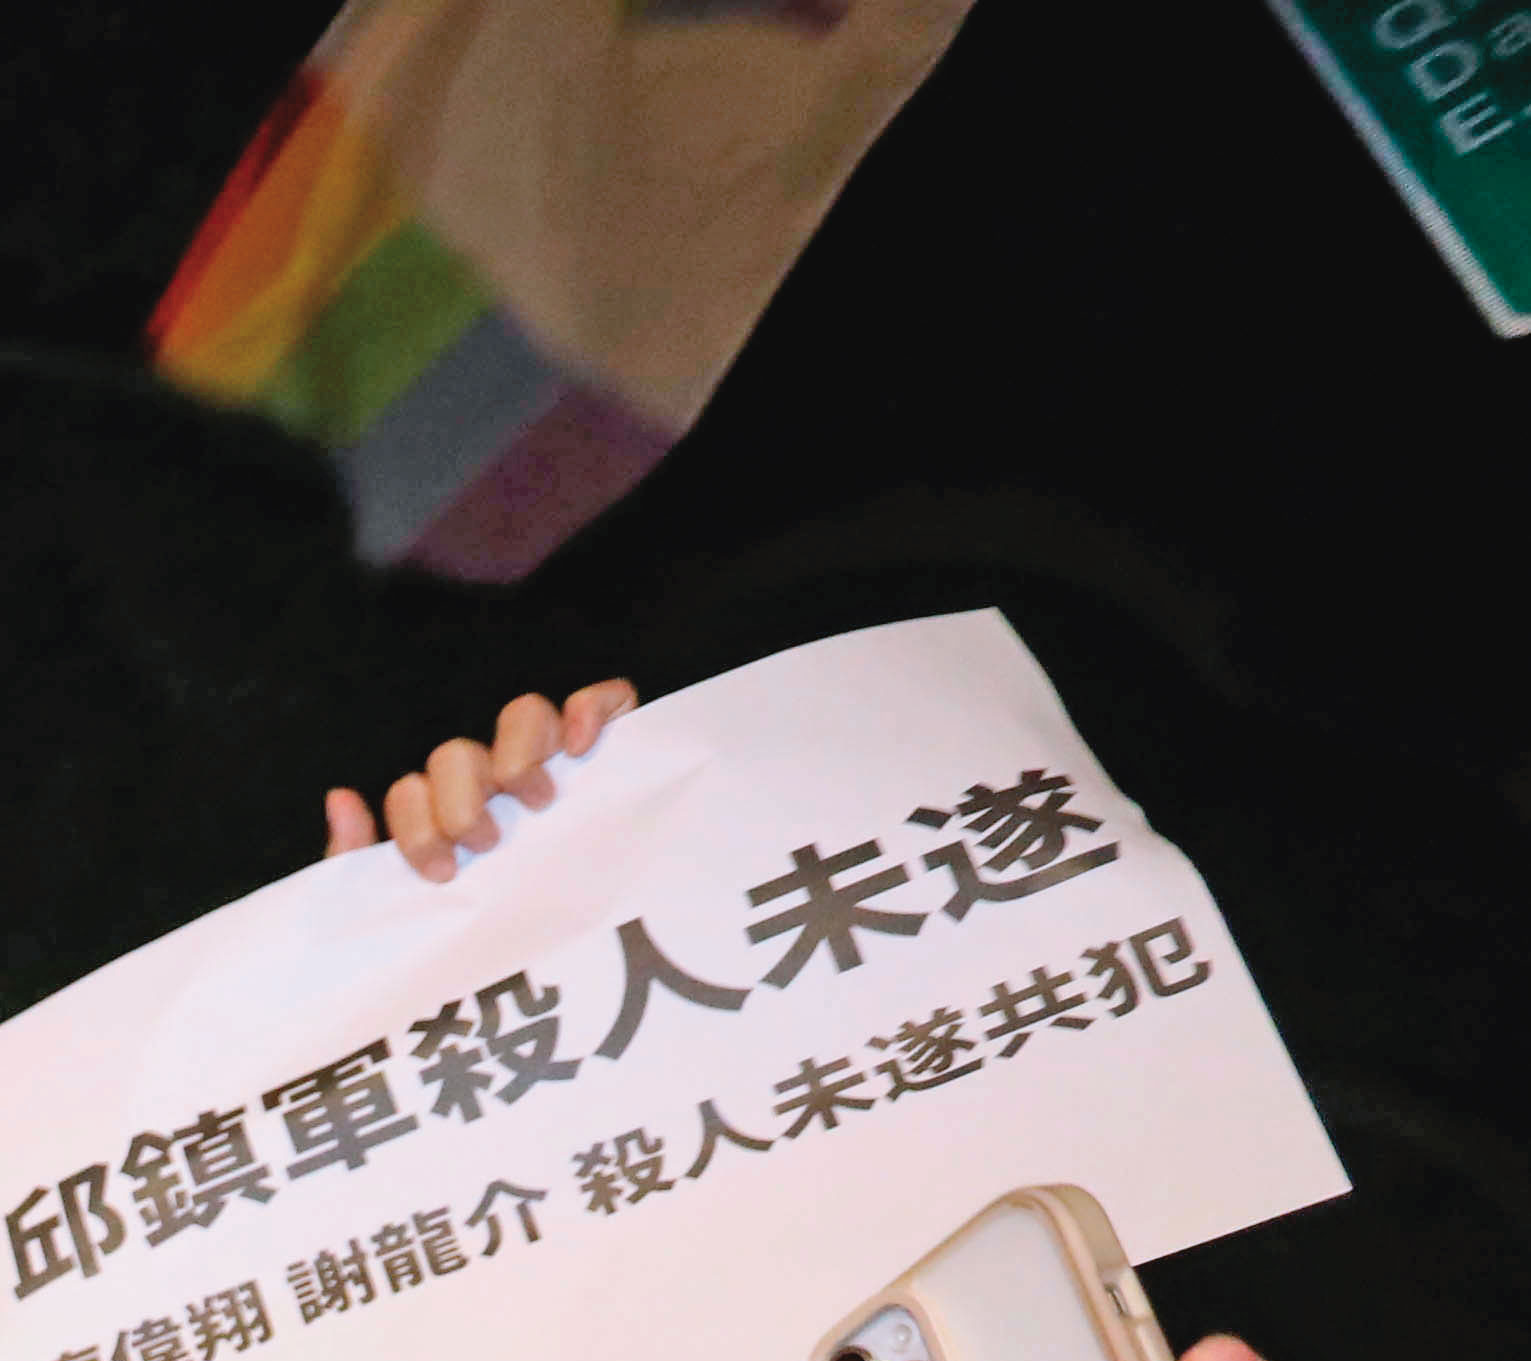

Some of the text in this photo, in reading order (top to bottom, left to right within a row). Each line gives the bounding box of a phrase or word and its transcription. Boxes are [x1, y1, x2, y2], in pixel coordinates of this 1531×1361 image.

[6, 768, 1122, 1300] 邱鎮軍殺人未遂
[288, 1177, 551, 1325] 謝龍介
[573, 915, 1214, 1215] 殺人未遂共犯
